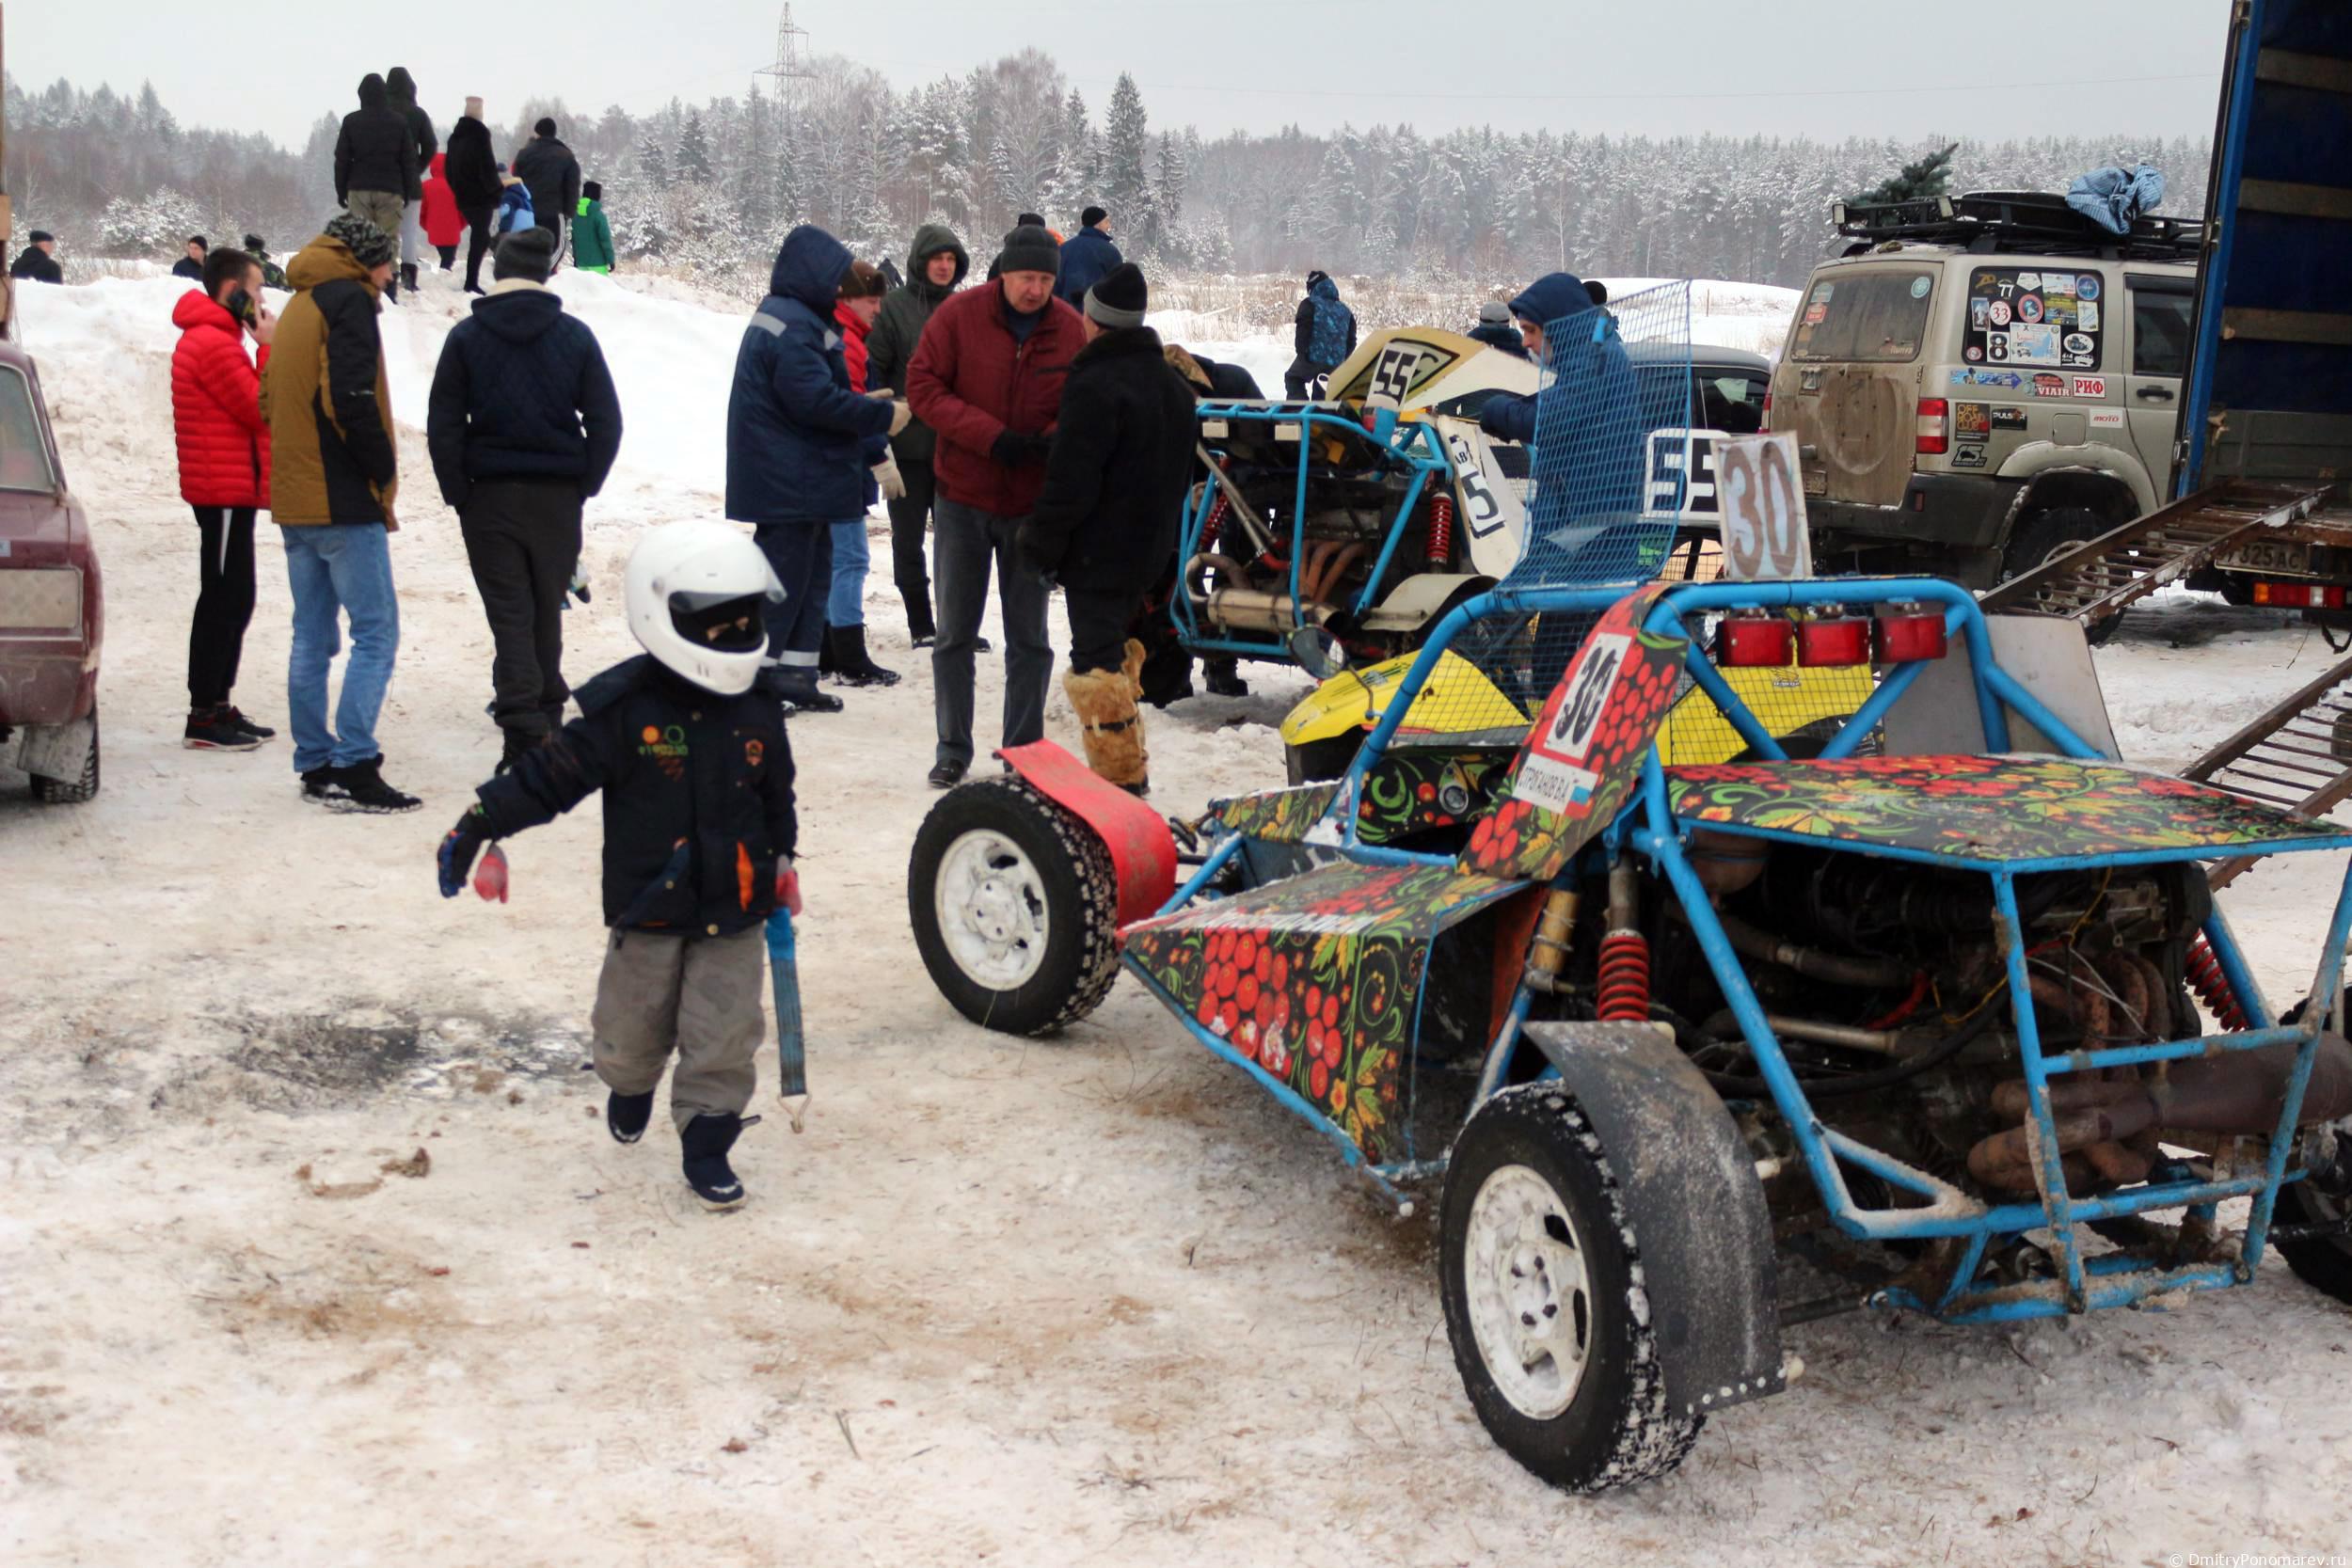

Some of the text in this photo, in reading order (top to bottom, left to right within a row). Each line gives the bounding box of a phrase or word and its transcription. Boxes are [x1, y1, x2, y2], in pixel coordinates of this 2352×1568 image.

[1992, 307, 2010, 321] 33
[1989, 333, 2009, 361] 8
[1374, 349, 1418, 407] 55
[2037, 387, 2071, 397] VIAIR
[2074, 380, 2104, 394] РИФ
[1724, 440, 1799, 578] 30
[1555, 646, 1618, 746] 30
